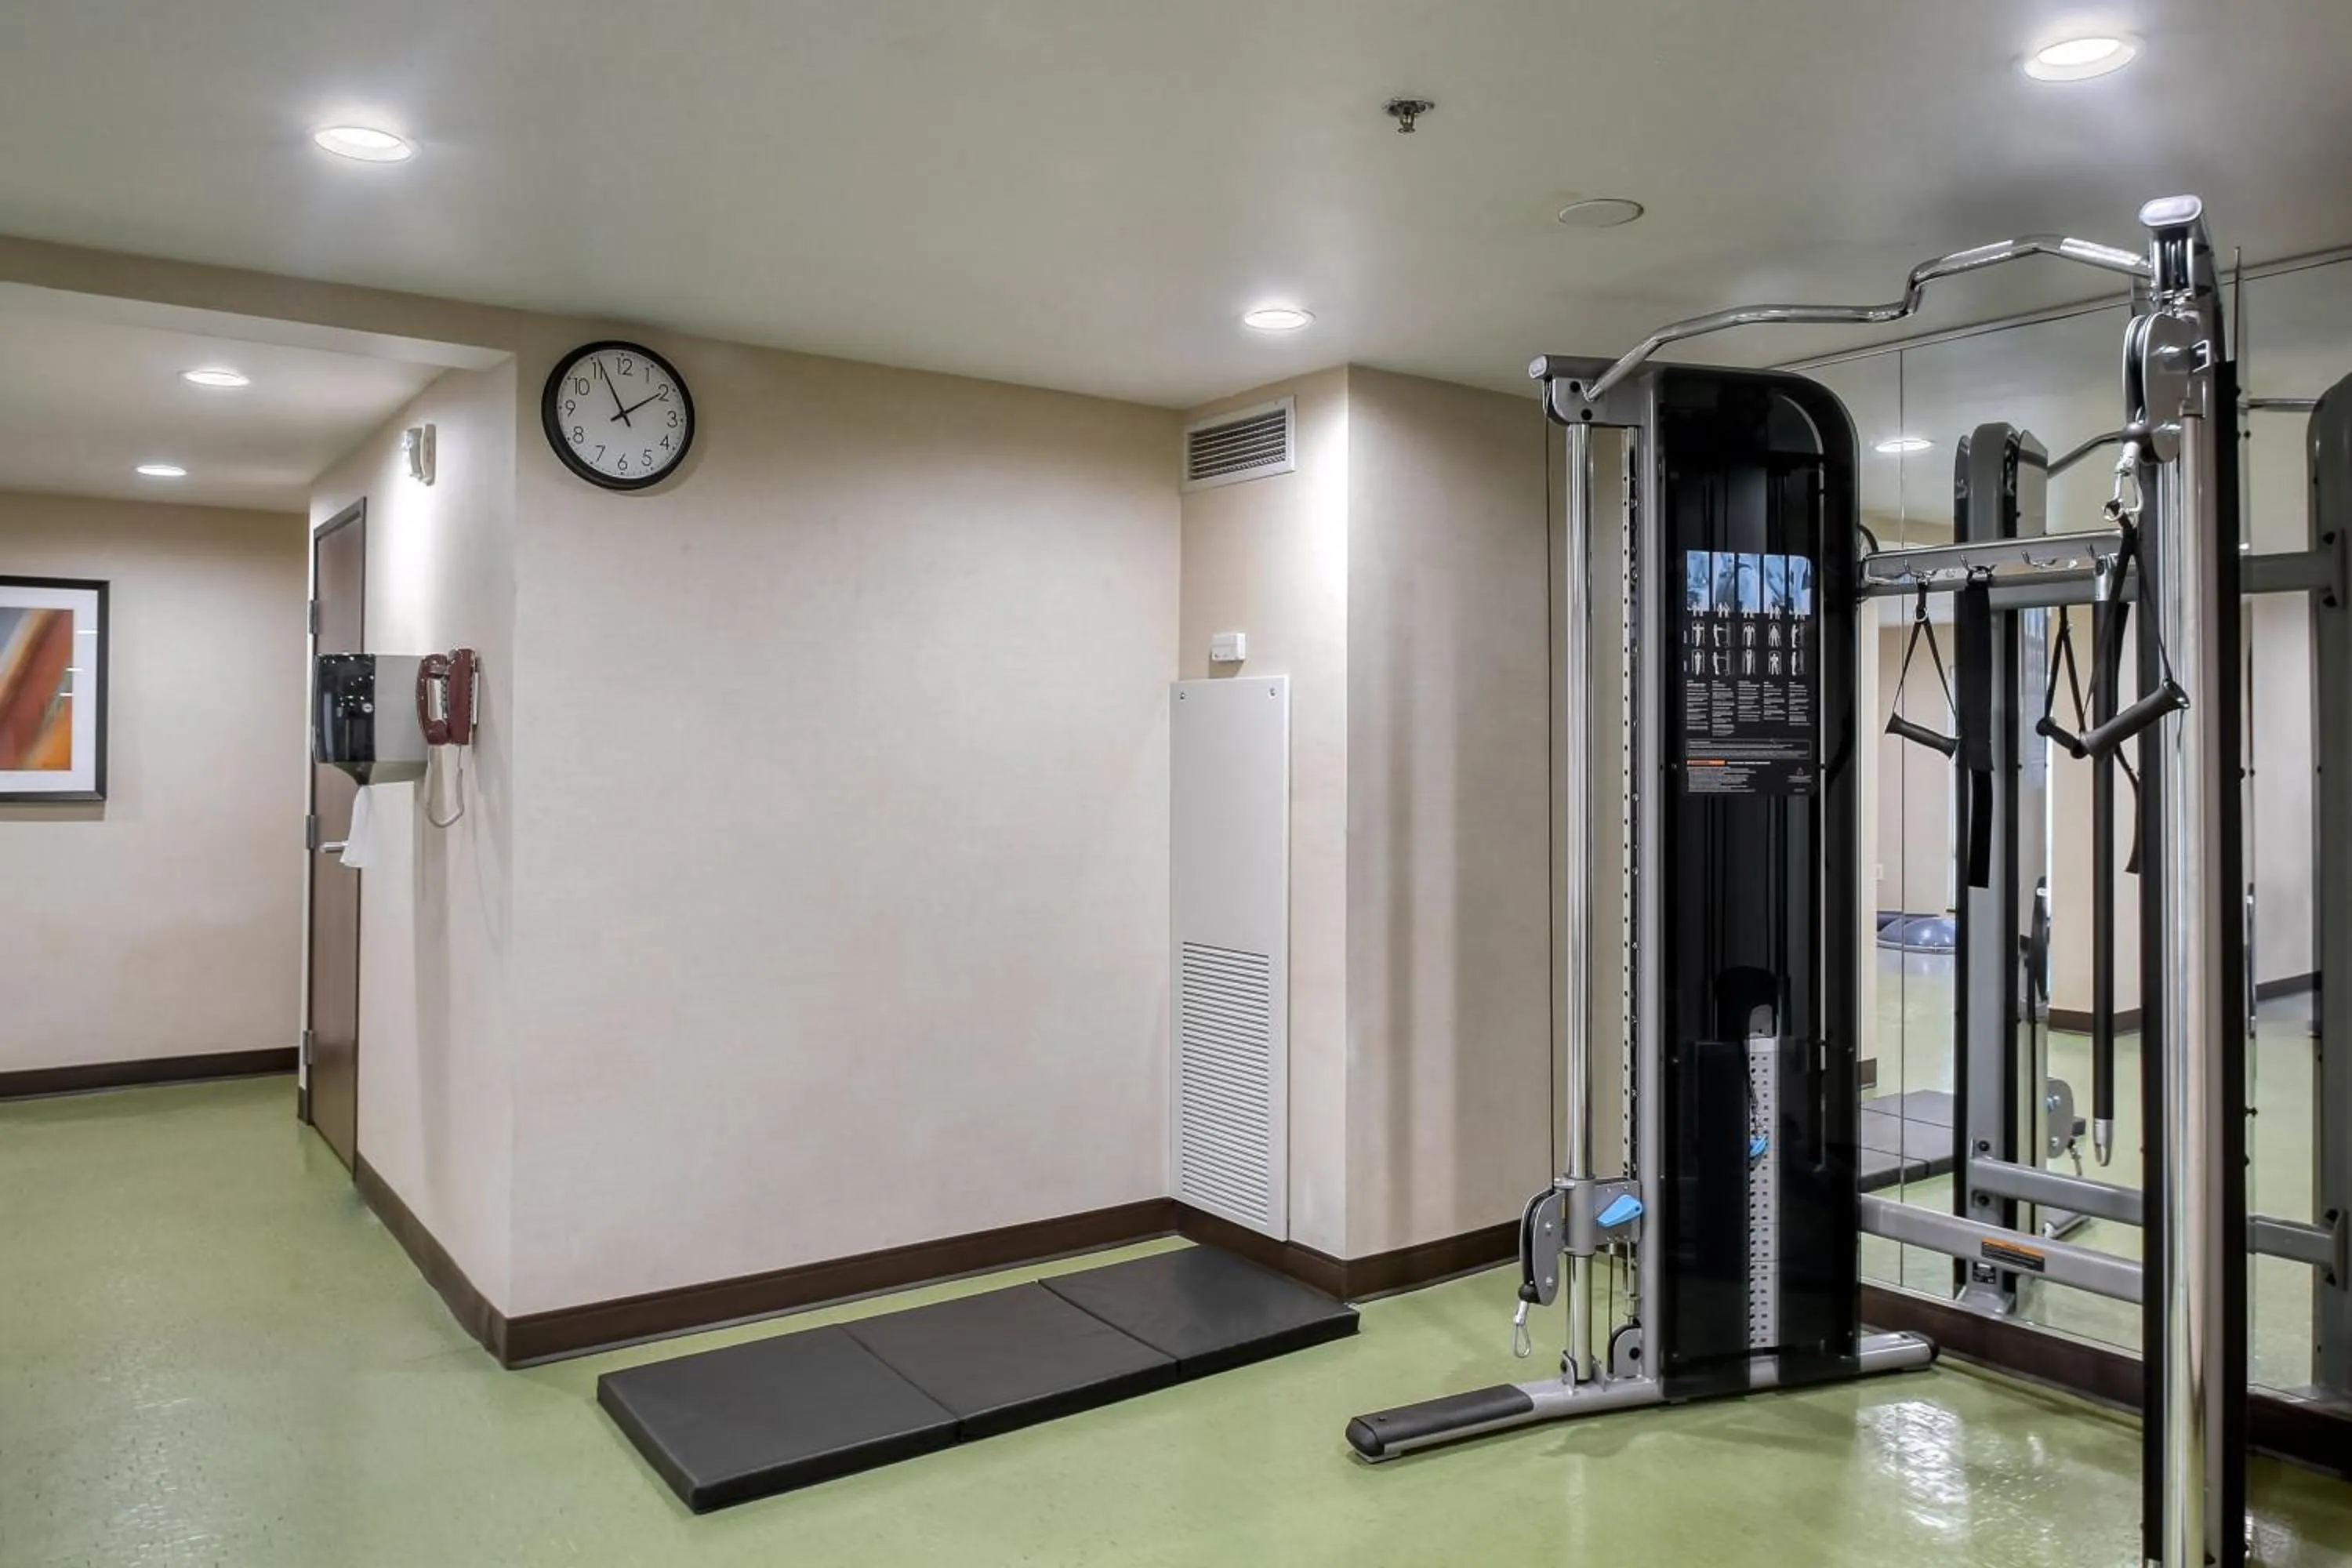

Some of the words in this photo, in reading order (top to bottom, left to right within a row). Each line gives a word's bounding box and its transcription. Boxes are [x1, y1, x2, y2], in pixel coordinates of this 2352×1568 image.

[592, 361, 603, 379] 11
[615, 358, 633, 376] 12
[644, 367, 650, 383] 1
[573, 377, 590, 395] 10
[658, 383, 669, 402] 2
[565, 399, 576, 417] 9
[667, 410, 678, 428] 3
[572, 426, 584, 444] 8
[659, 434, 670, 450] 4
[596, 445, 606, 463] 7
[617, 452, 627, 470] 6
[641, 448, 652, 466] 5
